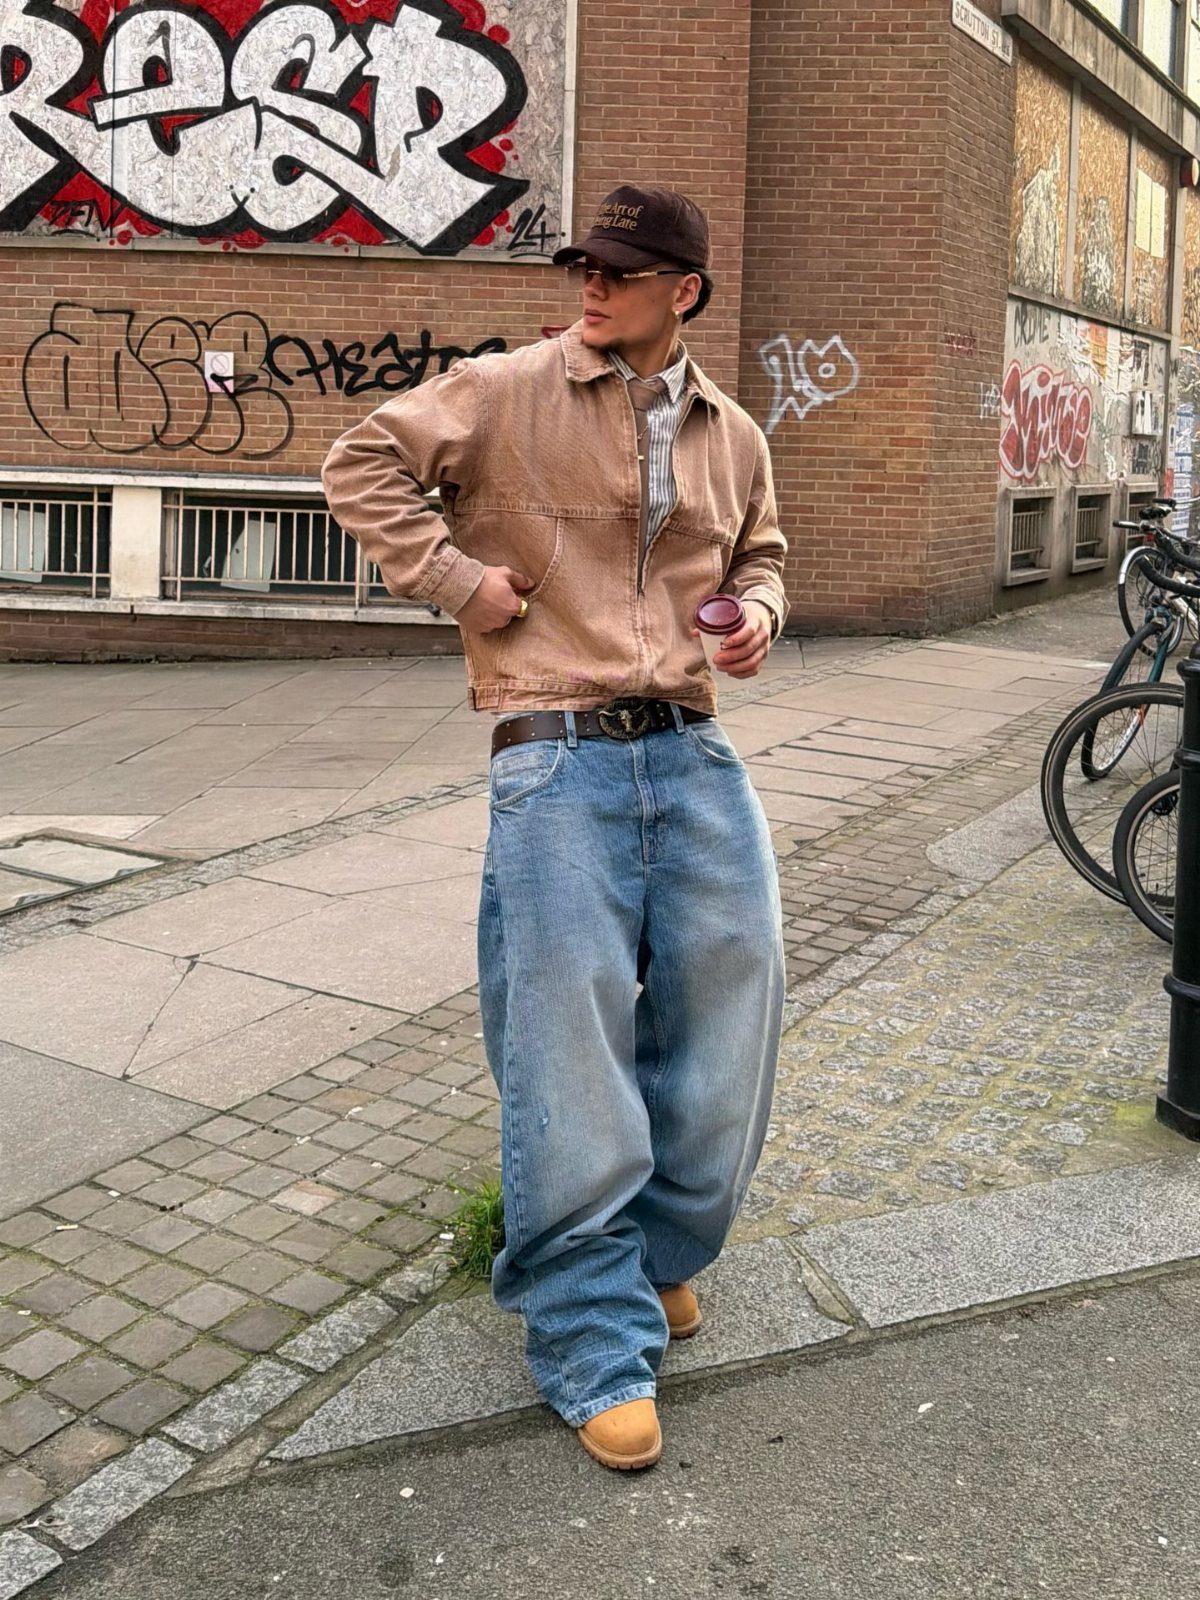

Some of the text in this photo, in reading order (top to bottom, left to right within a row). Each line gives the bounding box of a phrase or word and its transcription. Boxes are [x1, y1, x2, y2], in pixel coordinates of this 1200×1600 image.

[955, 1, 990, 41] SCRUTTON
[611, 202, 627, 215] Art
[627, 206, 644, 219] of
[611, 215, 638, 231] Late
